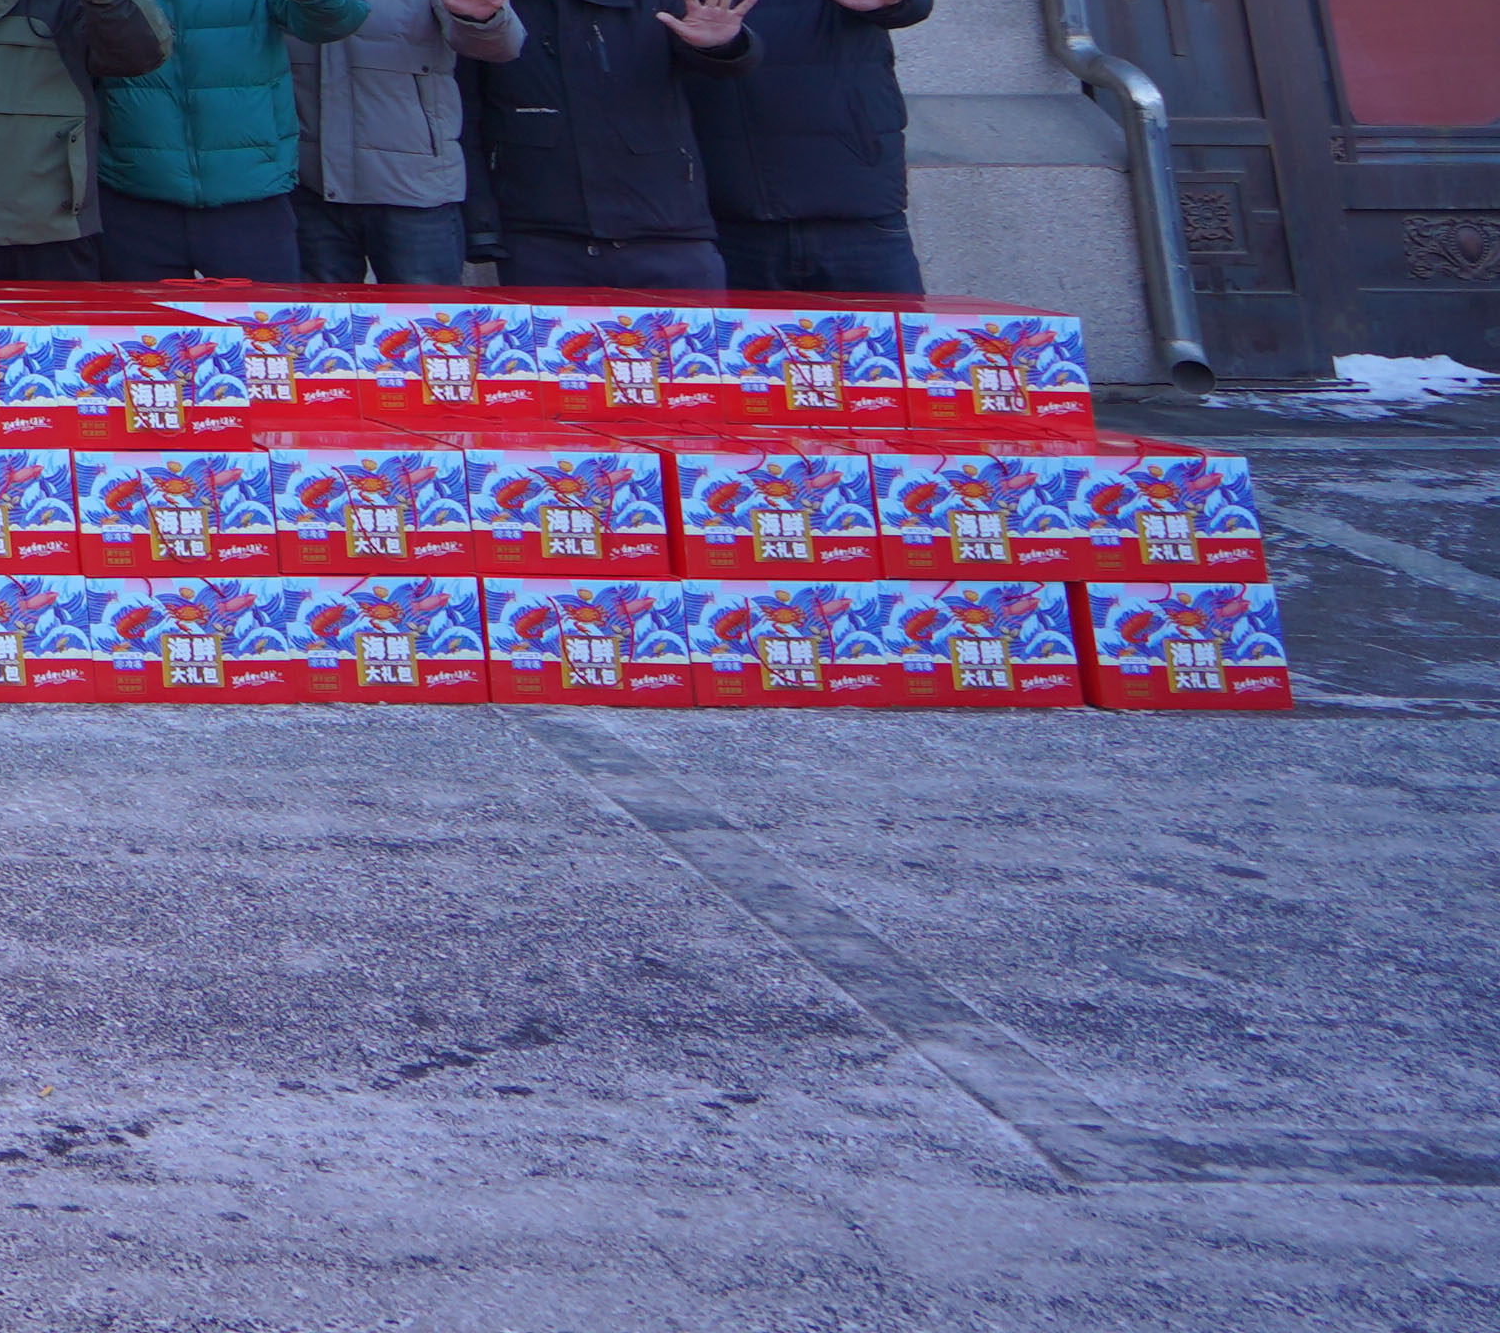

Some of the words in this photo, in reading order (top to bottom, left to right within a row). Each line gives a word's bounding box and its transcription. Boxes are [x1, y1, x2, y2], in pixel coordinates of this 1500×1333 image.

[244, 357, 289, 379] 海鲜
[248, 385, 291, 400] 大礼包
[545, 509, 594, 532] 海鲜
[757, 513, 805, 536] 海鲜
[954, 514, 1002, 537] 海鲜
[1142, 515, 1190, 538] 海鲜
[549, 538, 596, 554] 大礼包
[761, 542, 807, 558] 大礼包
[959, 543, 1005, 559] 大礼包
[1147, 544, 1193, 560] 大礼包
[167, 637, 216, 661] 海鲜
[361, 636, 410, 660] 海鲜
[955, 640, 1005, 664] 海鲜
[1169, 642, 1217, 666] 海鲜
[171, 666, 218, 683] 大礼包
[365, 665, 412, 682] 大礼包
[960, 669, 1009, 686] 大礼包
[1174, 671, 1220, 688] 大礼包
